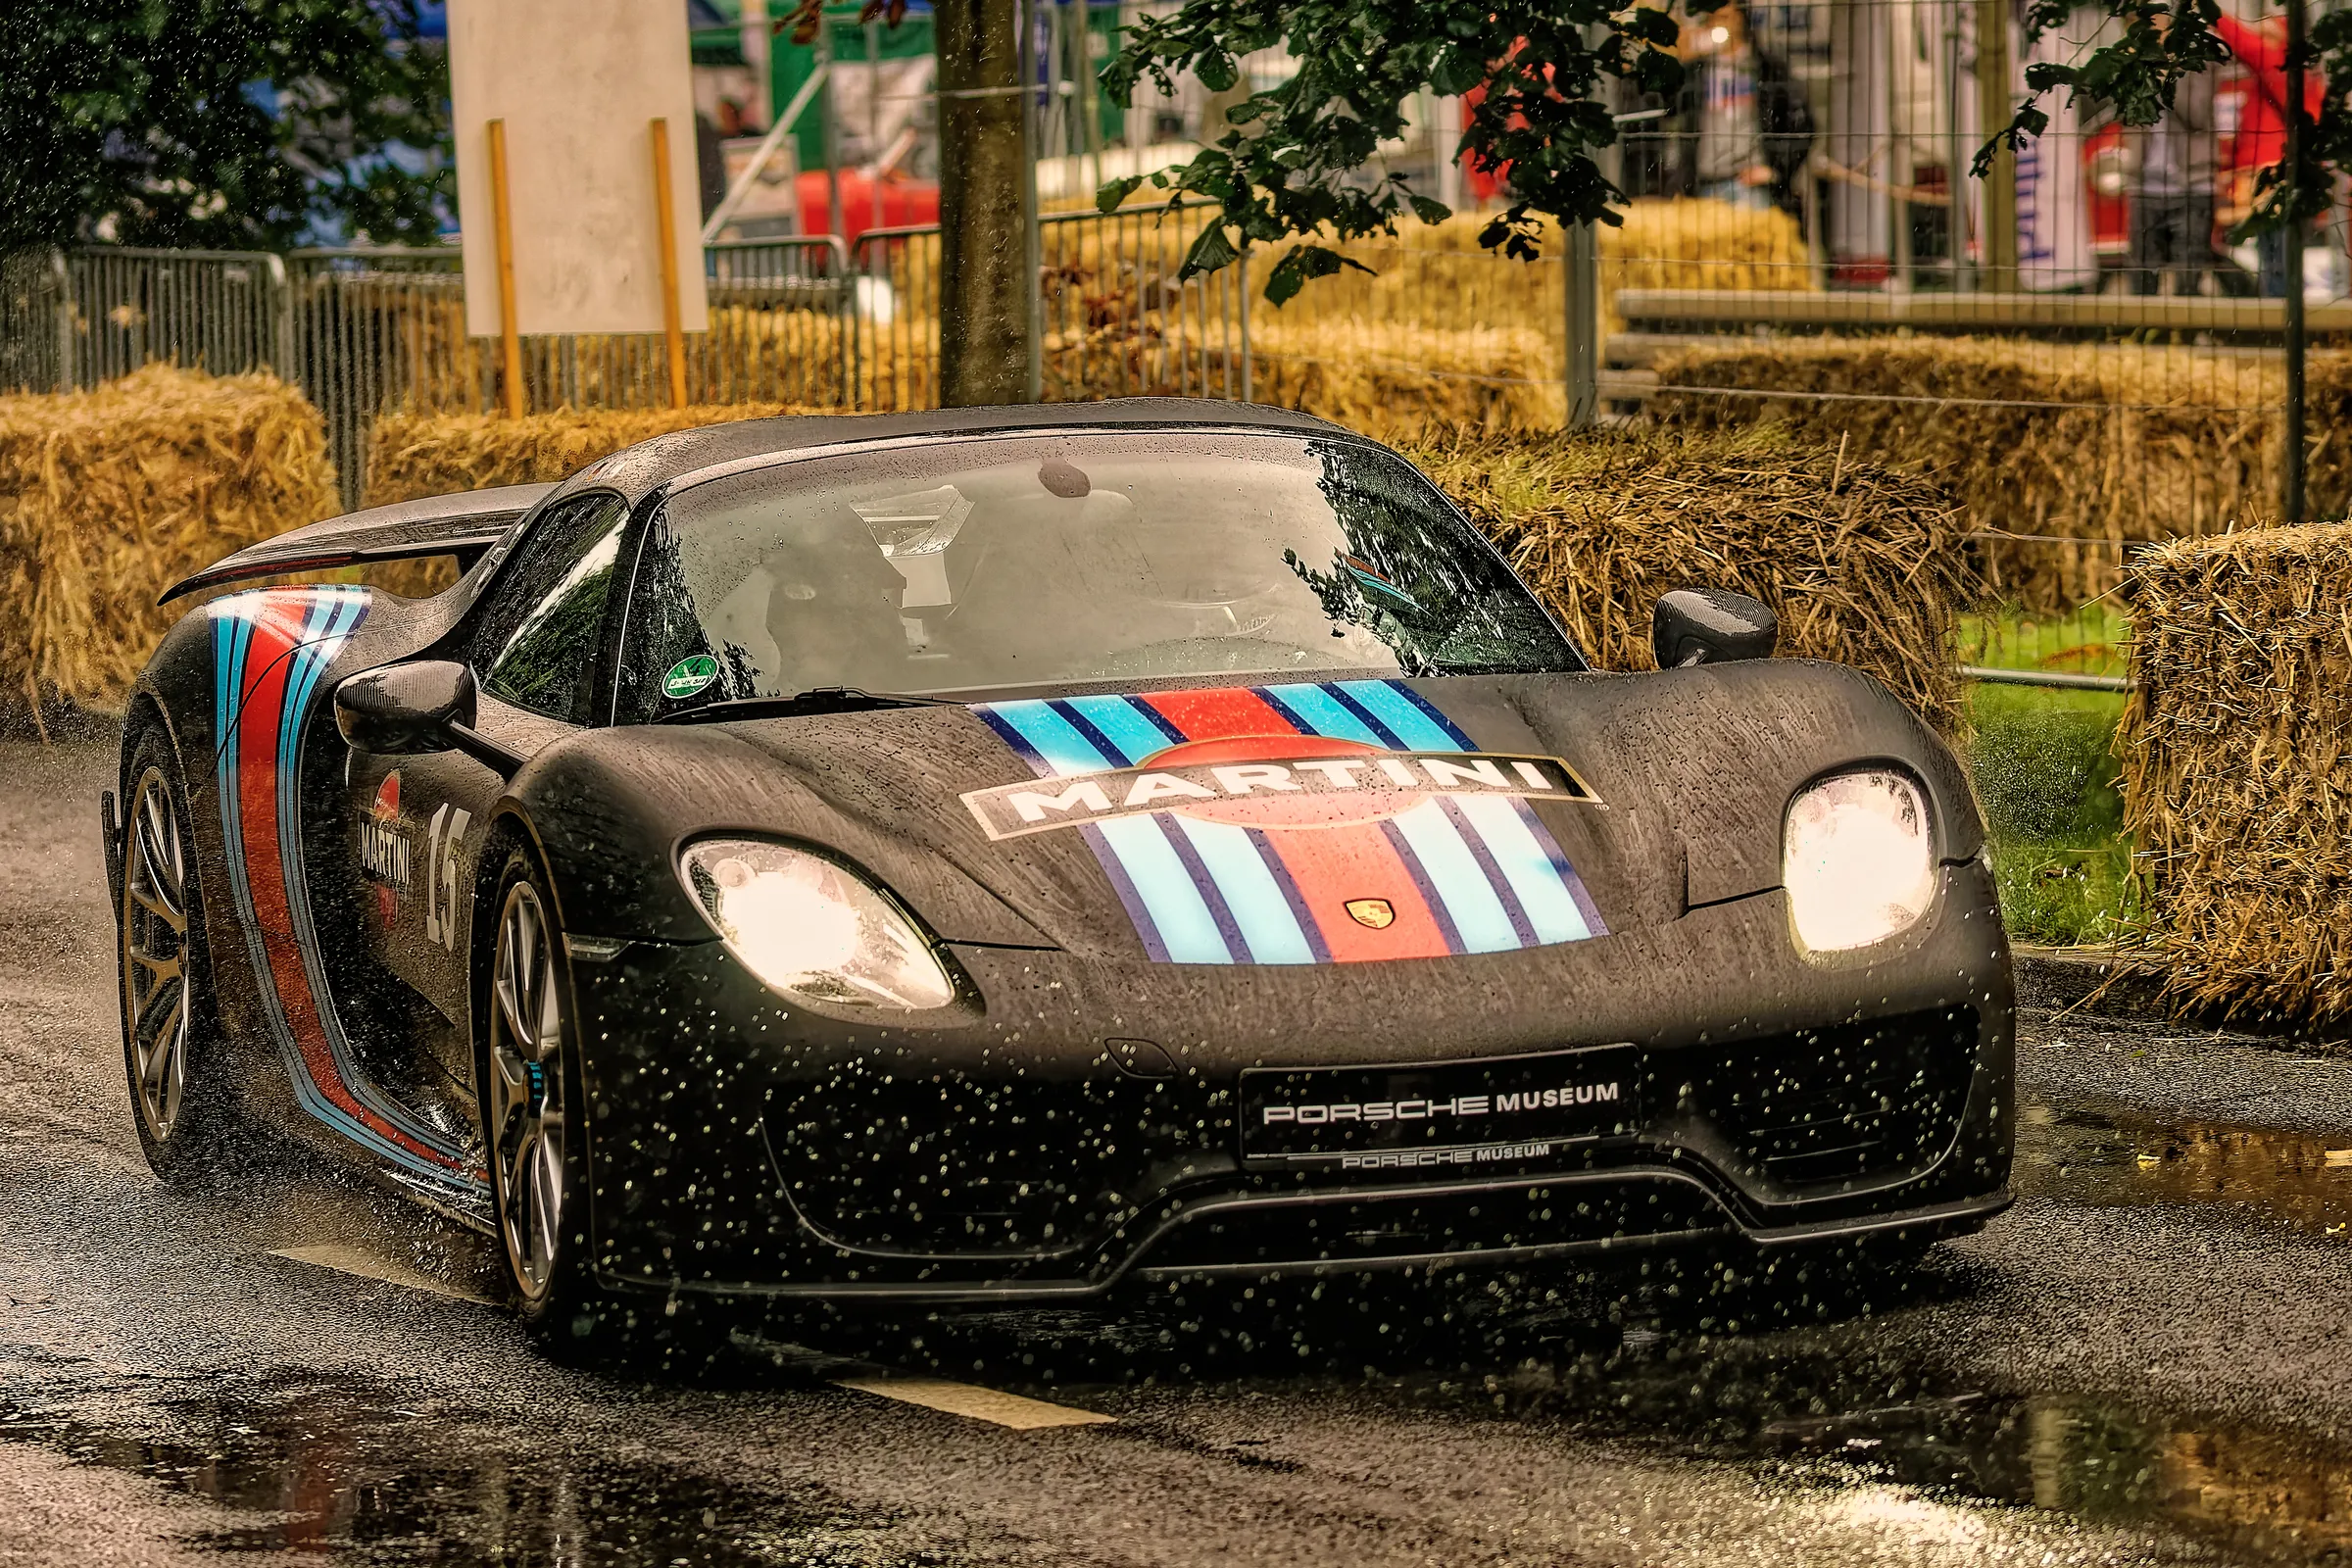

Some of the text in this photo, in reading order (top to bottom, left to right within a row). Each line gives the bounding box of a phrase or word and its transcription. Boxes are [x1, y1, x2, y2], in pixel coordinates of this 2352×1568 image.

[1006, 759, 1555, 822] MARTINI
[360, 821, 410, 884] MARTINI
[426, 802, 472, 953] 15
[1263, 1082, 1619, 1125] PORSCHE MUSEUM
[1341, 1144, 1550, 1169] PORSCHE MUSEUM
